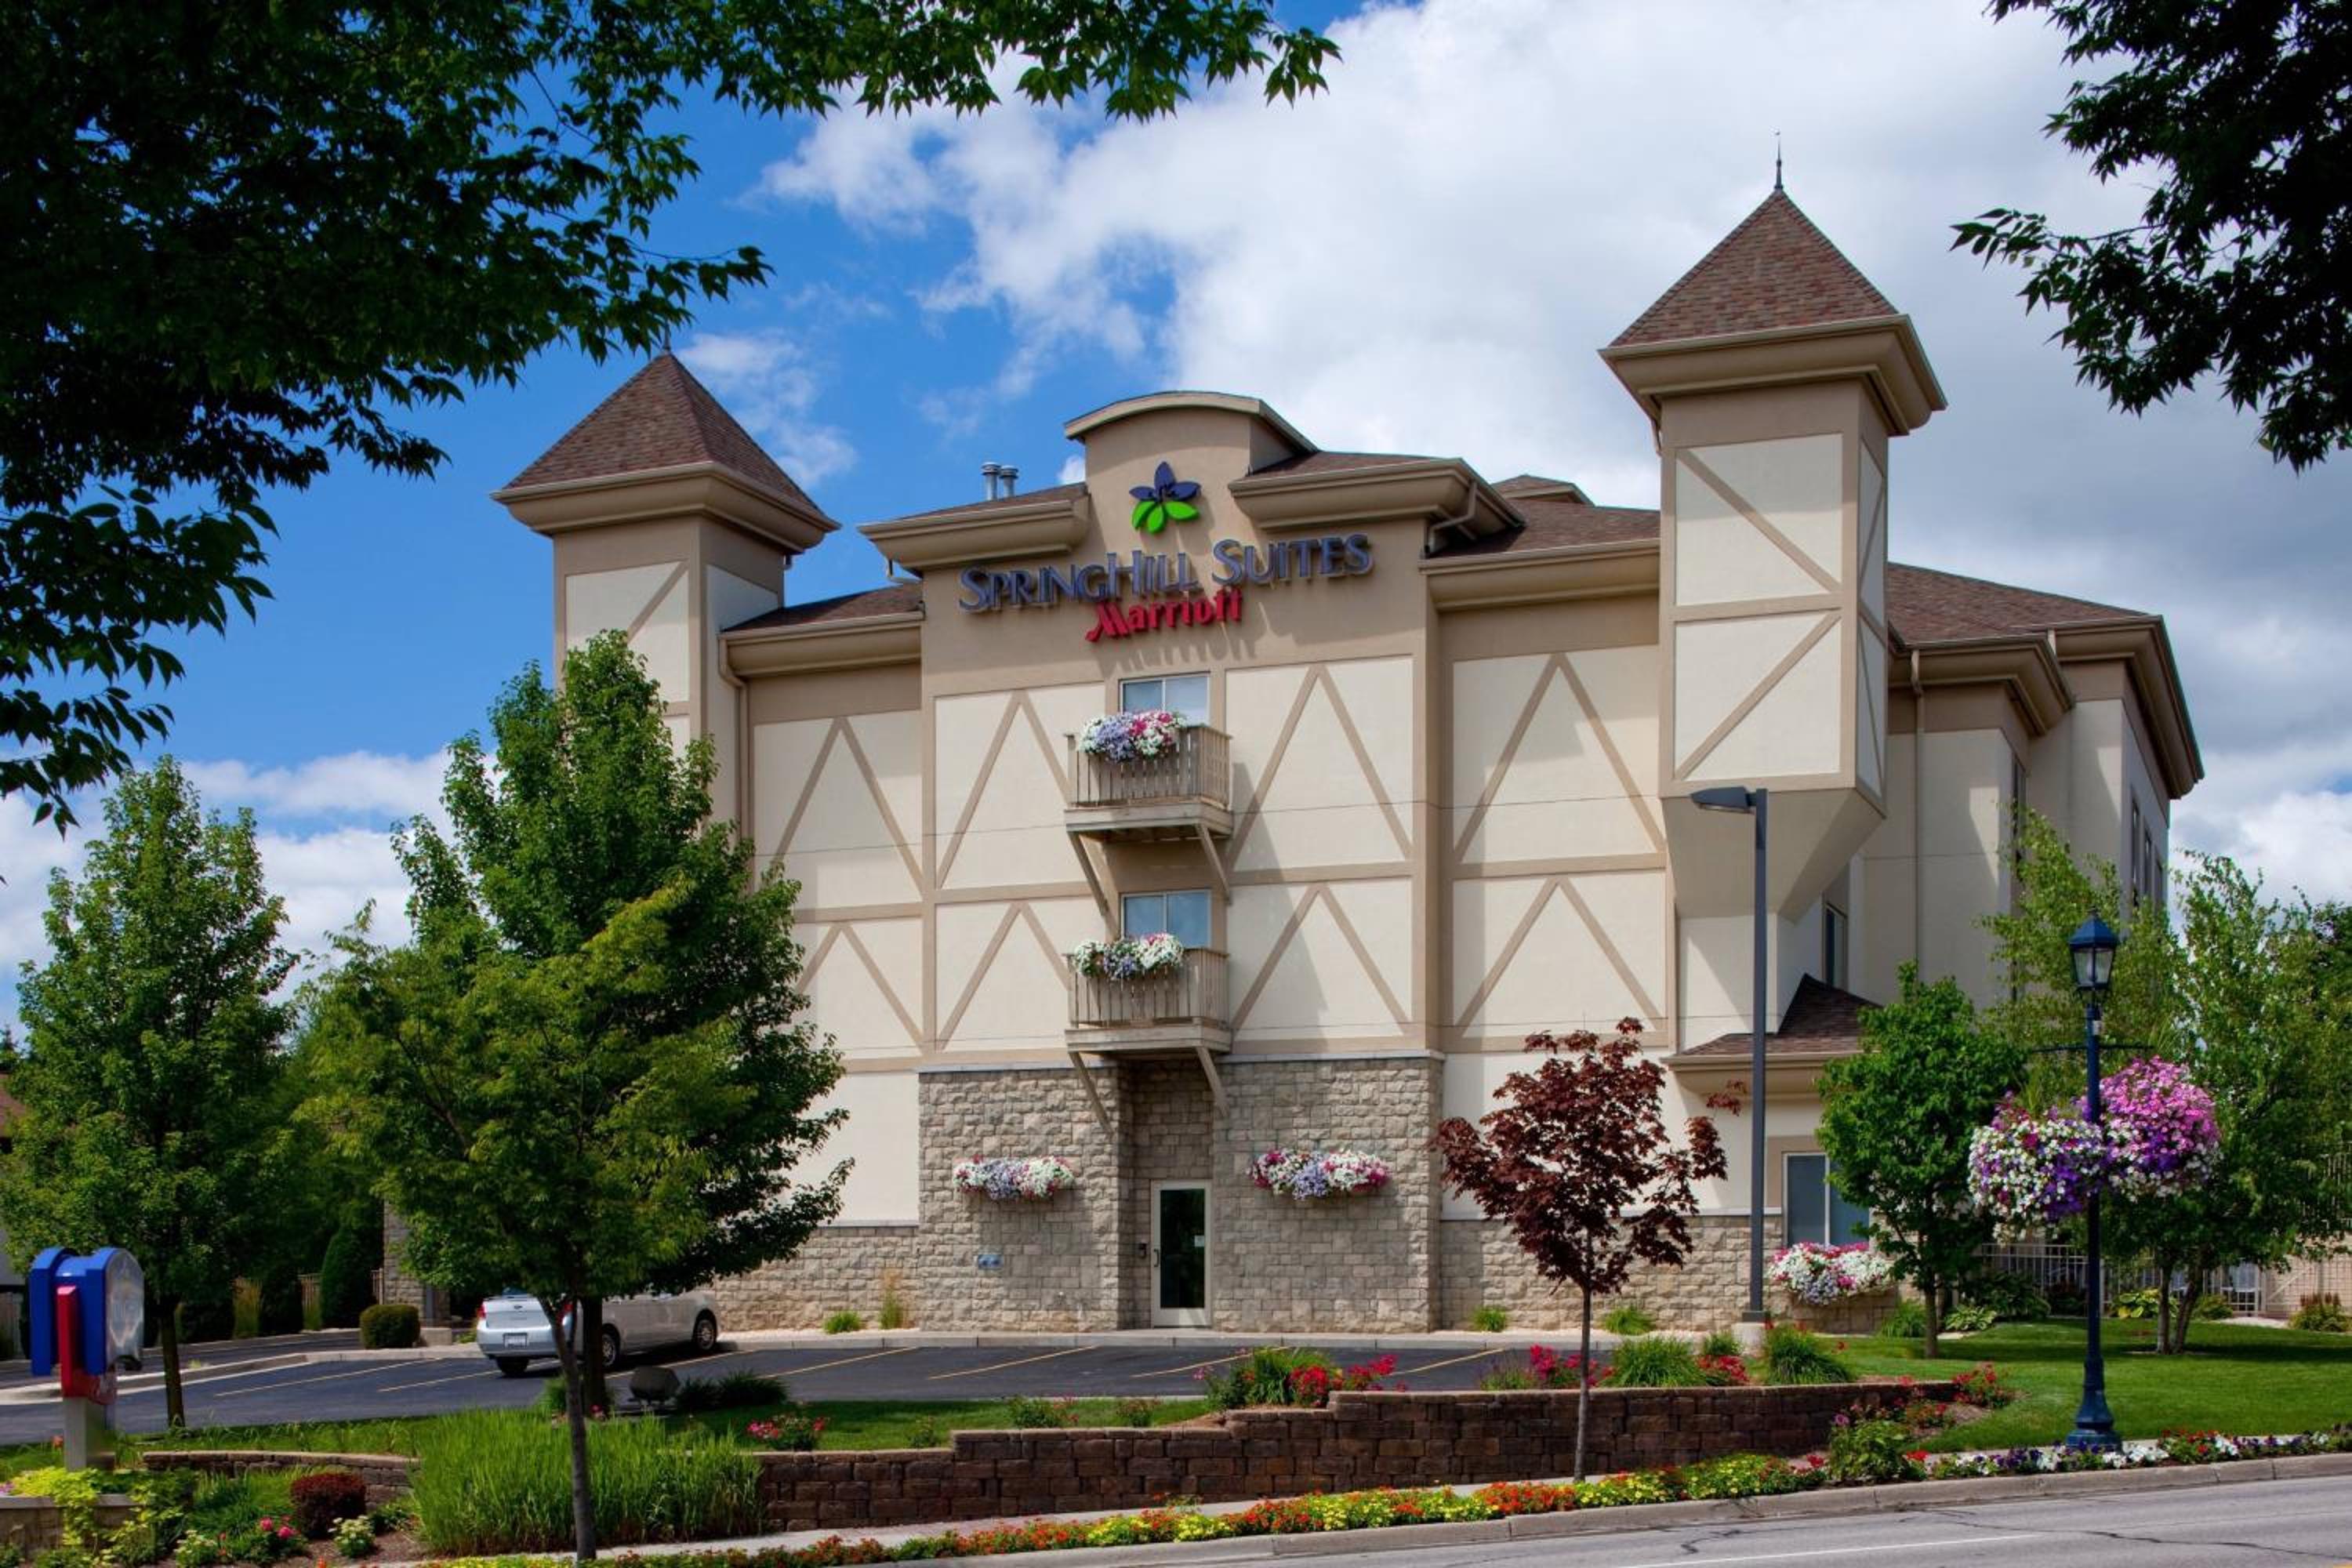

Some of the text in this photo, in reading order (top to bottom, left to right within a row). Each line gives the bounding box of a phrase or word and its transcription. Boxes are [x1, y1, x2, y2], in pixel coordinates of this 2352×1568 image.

[959, 533, 1374, 612] SPRINGHILL SUITES
[1085, 586, 1243, 641] Marriott
